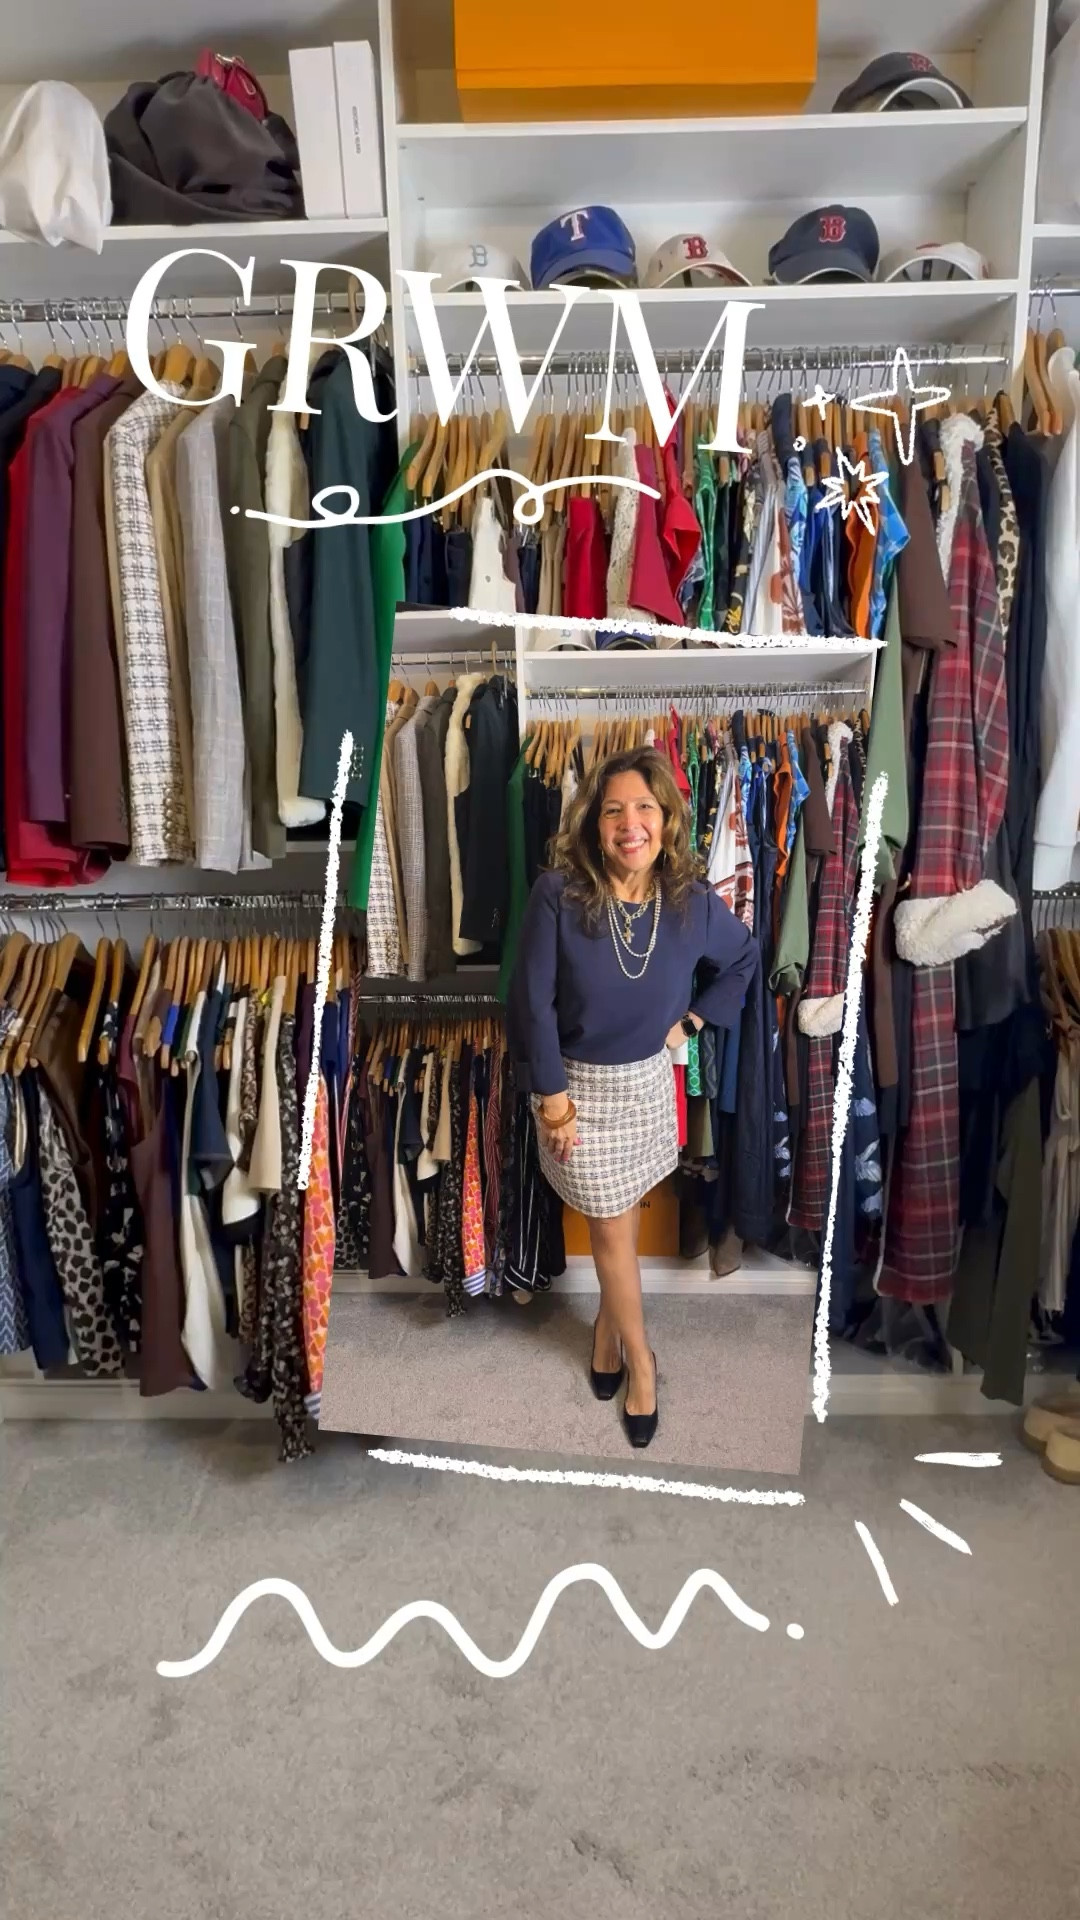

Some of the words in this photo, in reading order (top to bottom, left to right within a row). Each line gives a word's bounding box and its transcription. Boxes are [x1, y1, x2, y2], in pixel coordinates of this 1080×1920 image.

[560, 209, 590, 242] T
[818, 215, 847, 243] B
[468, 244, 488, 268] B
[682, 236, 709, 260] B
